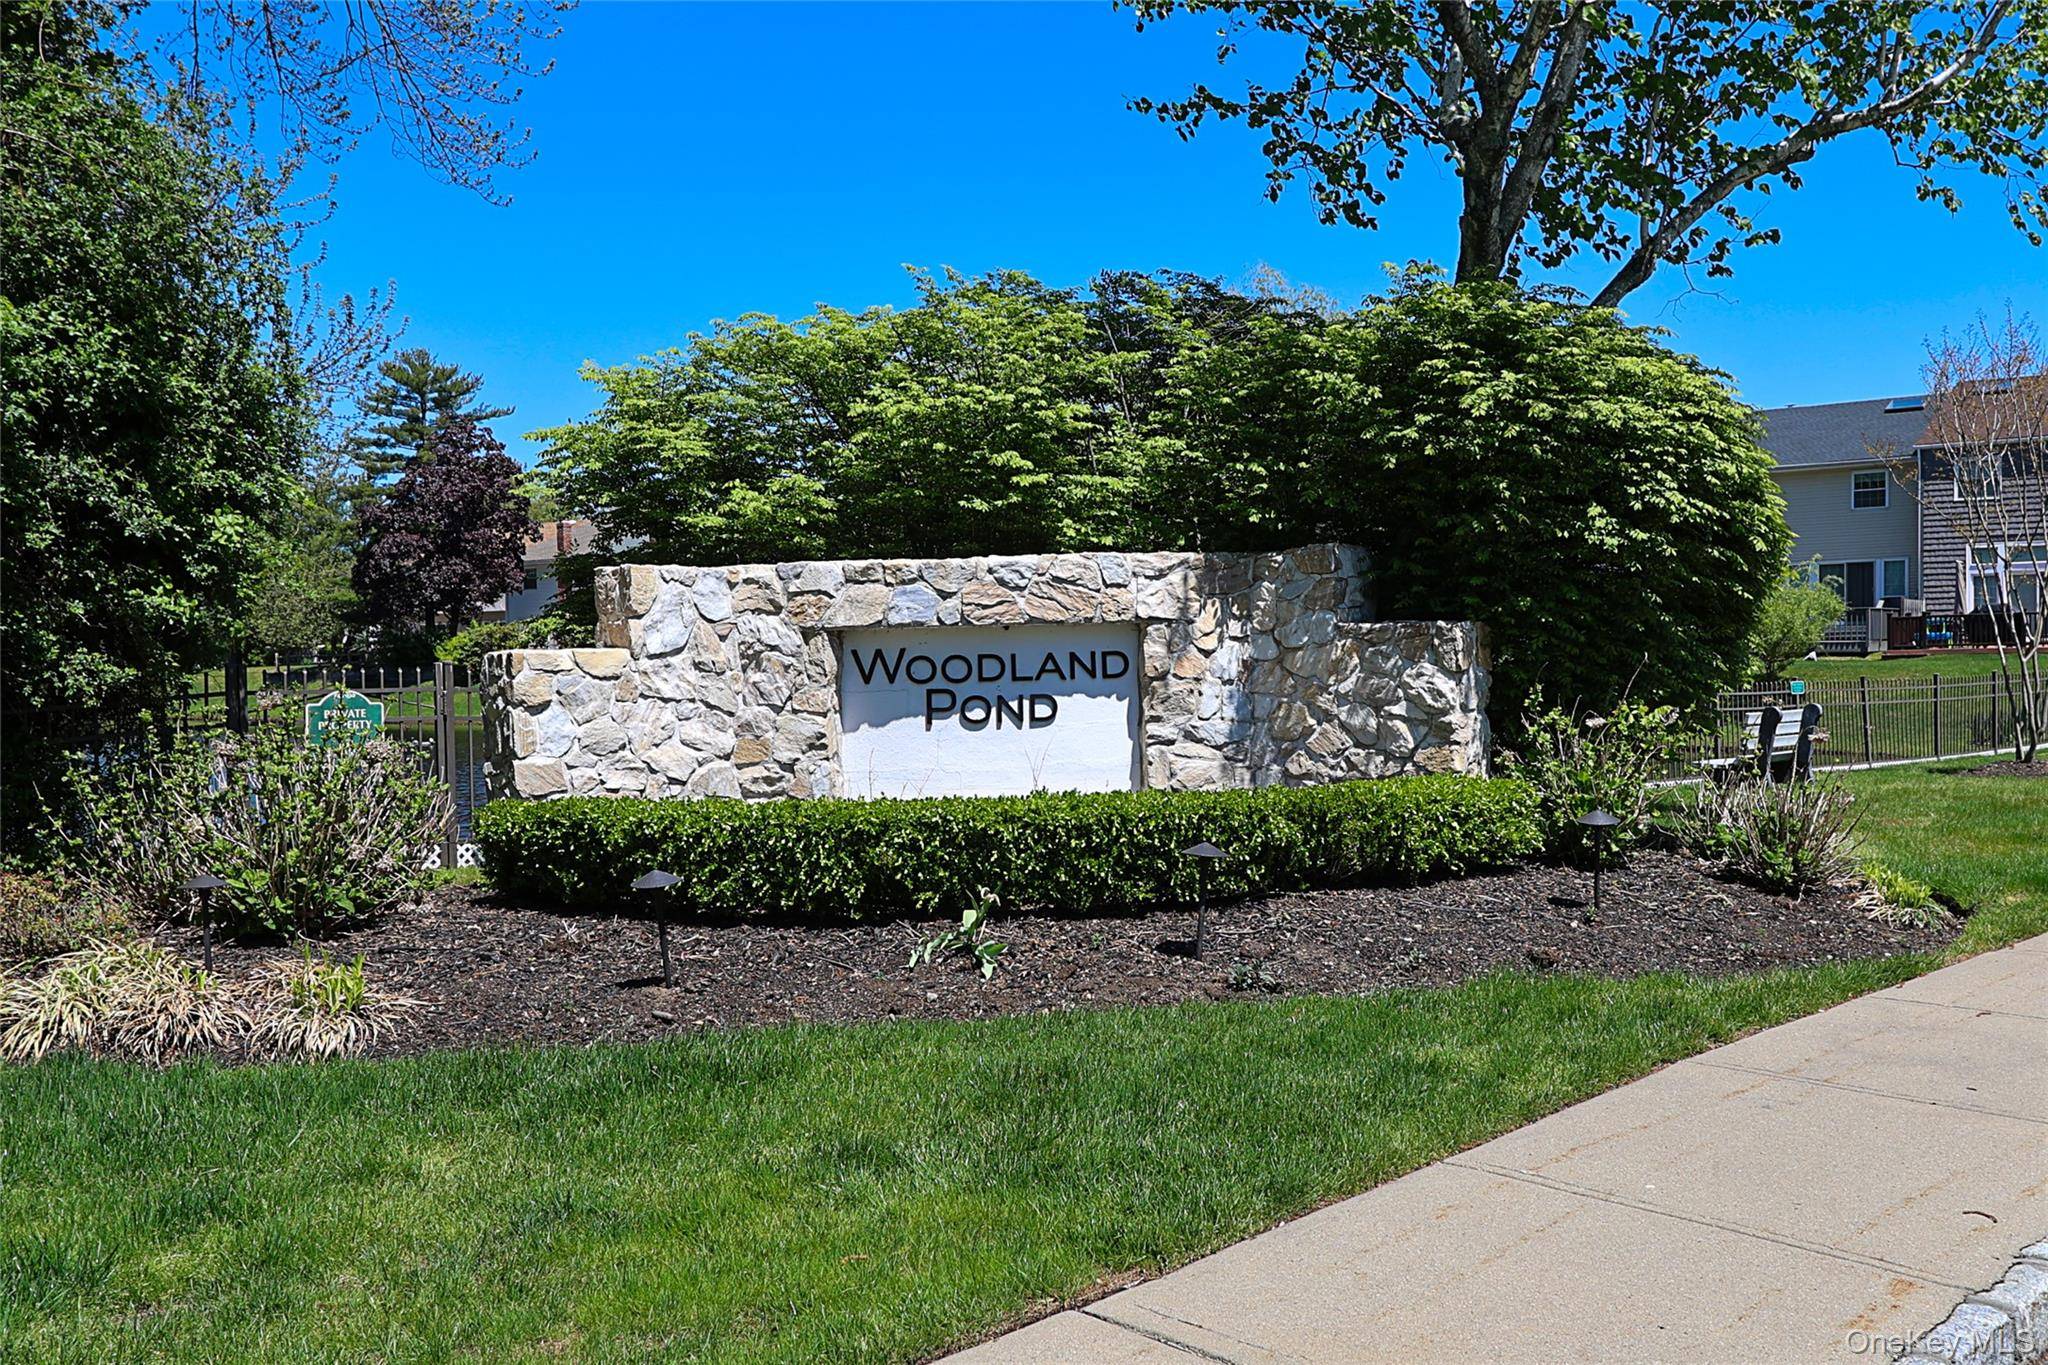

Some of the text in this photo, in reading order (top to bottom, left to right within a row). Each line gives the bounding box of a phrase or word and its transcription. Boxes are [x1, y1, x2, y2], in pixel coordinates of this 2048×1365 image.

[851, 648, 1130, 685] WOODLAND
[323, 708, 367, 719] PRIVATE
[925, 688, 1058, 731] POND
